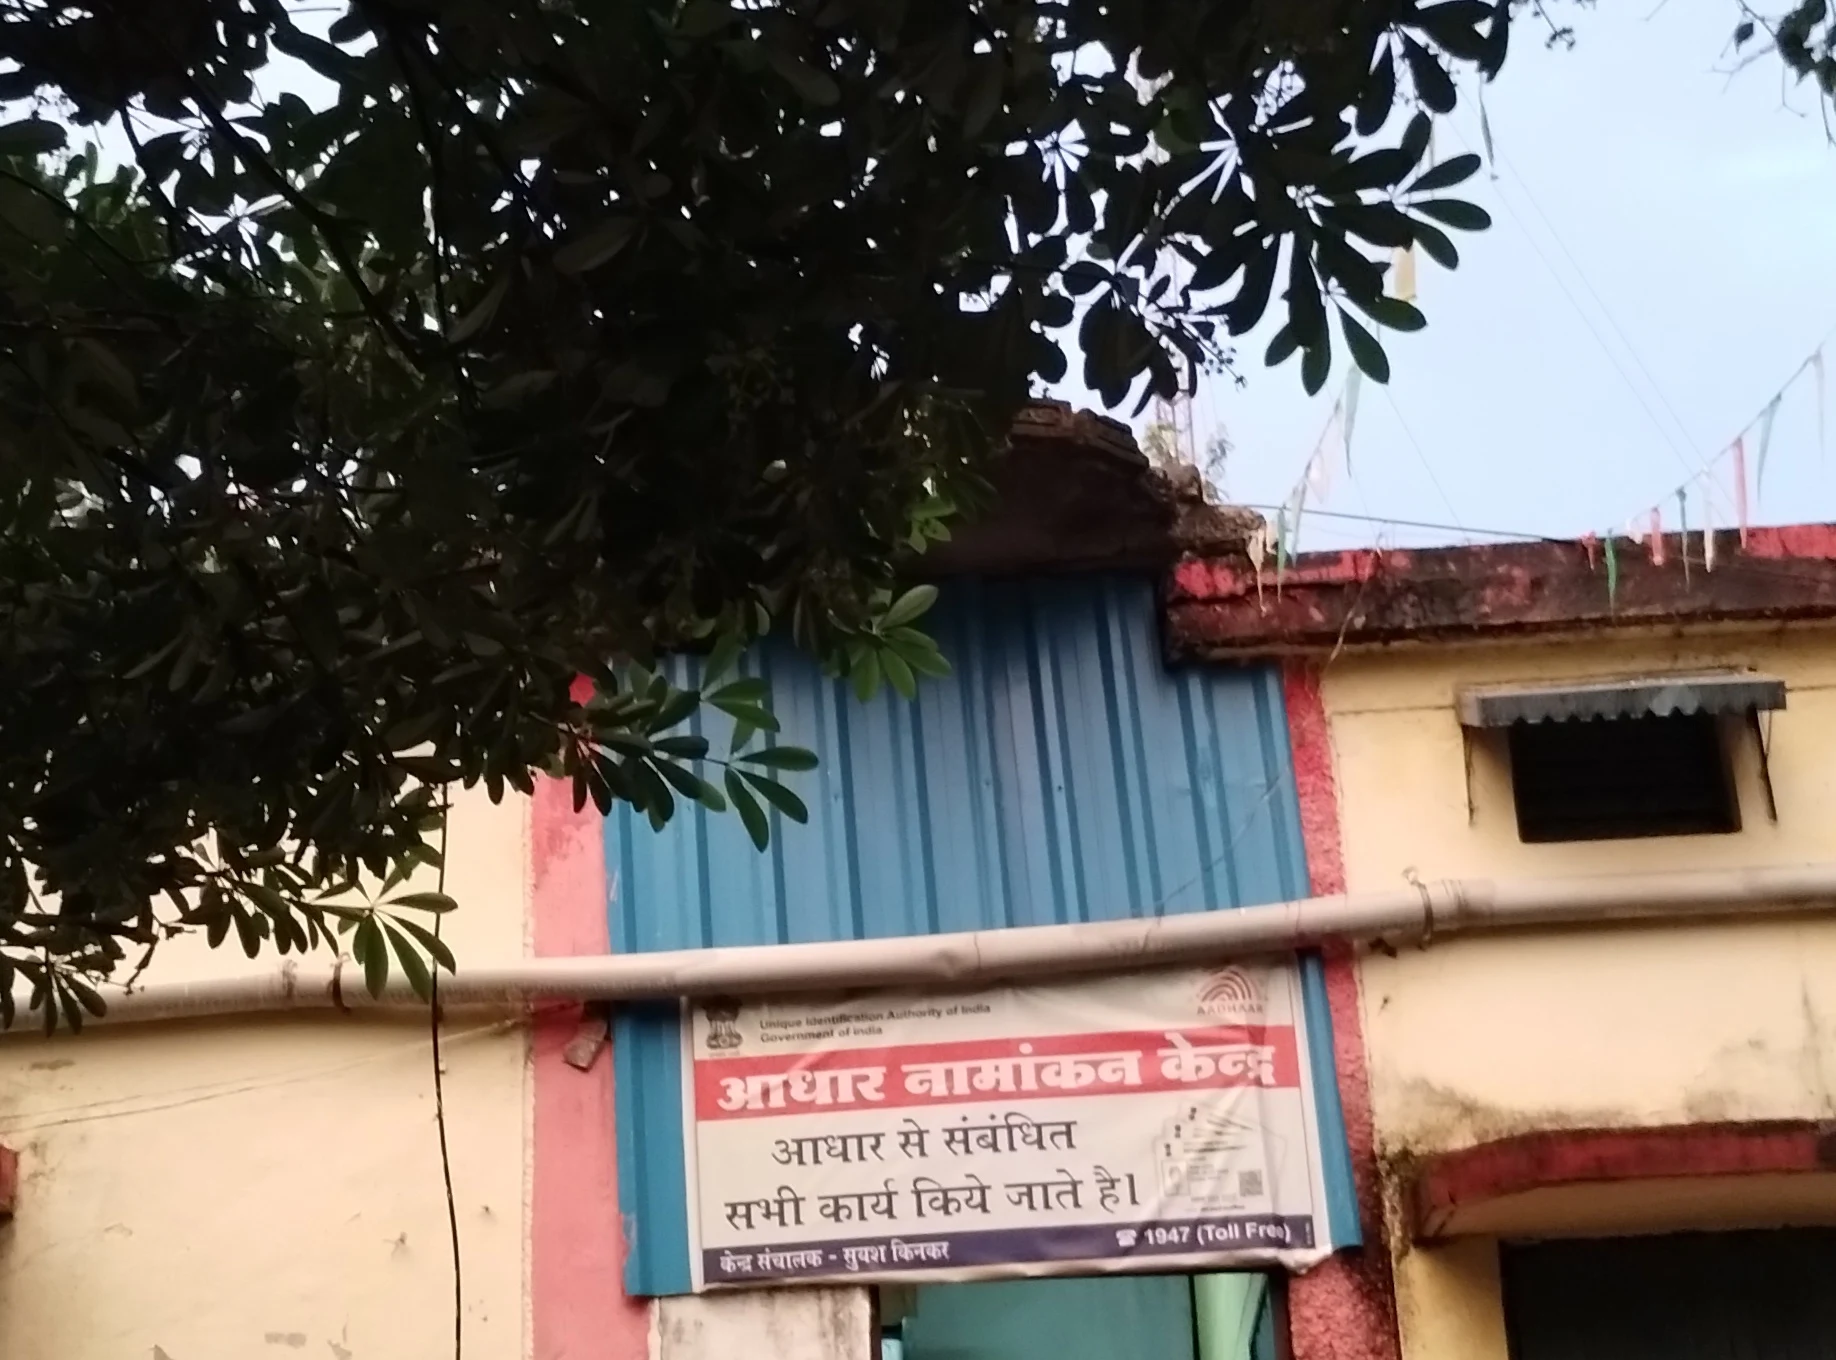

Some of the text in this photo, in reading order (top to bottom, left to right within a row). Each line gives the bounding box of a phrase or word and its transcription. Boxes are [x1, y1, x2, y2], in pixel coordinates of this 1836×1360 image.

[759, 1003, 991, 1031] Unique Identification Authority of India
[1197, 1003, 1264, 1016] AADHAAR
[760, 1027, 835, 1044] Government
[838, 1027, 850, 1038] of
[716, 1032, 1277, 1112] आधार नामांकन केन्द्र
[771, 1112, 1078, 1166] आधार से संबंधित
[724, 1185, 806, 1231] सभी
[817, 1178, 898, 1224] कार्य
[911, 1173, 992, 1218] किये
[1004, 1168, 1084, 1212] जाते
[1144, 1226, 1191, 1246] 1947
[1197, 1222, 1240, 1246] (Toll
[757, 1248, 823, 1272] संचालक
[890, 1238, 950, 1263] किनकर
